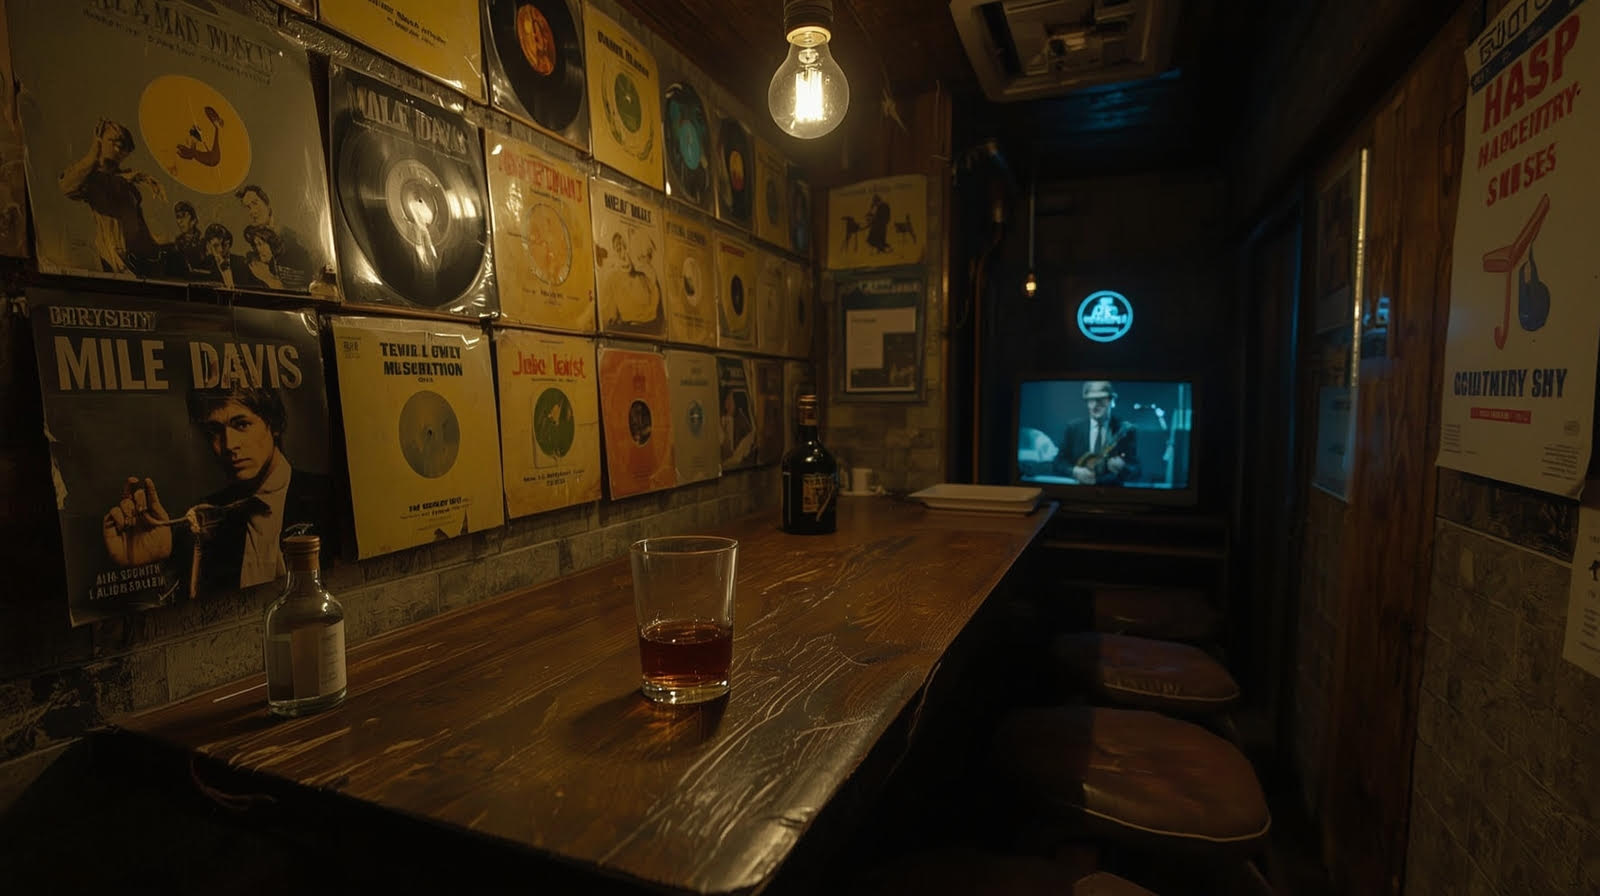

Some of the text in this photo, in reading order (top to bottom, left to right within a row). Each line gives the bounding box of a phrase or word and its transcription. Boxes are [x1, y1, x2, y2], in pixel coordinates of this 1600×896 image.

[1483, 15, 1580, 133] HASP
[54, 336, 169, 391] MILE
[188, 341, 303, 391] DAVIS
